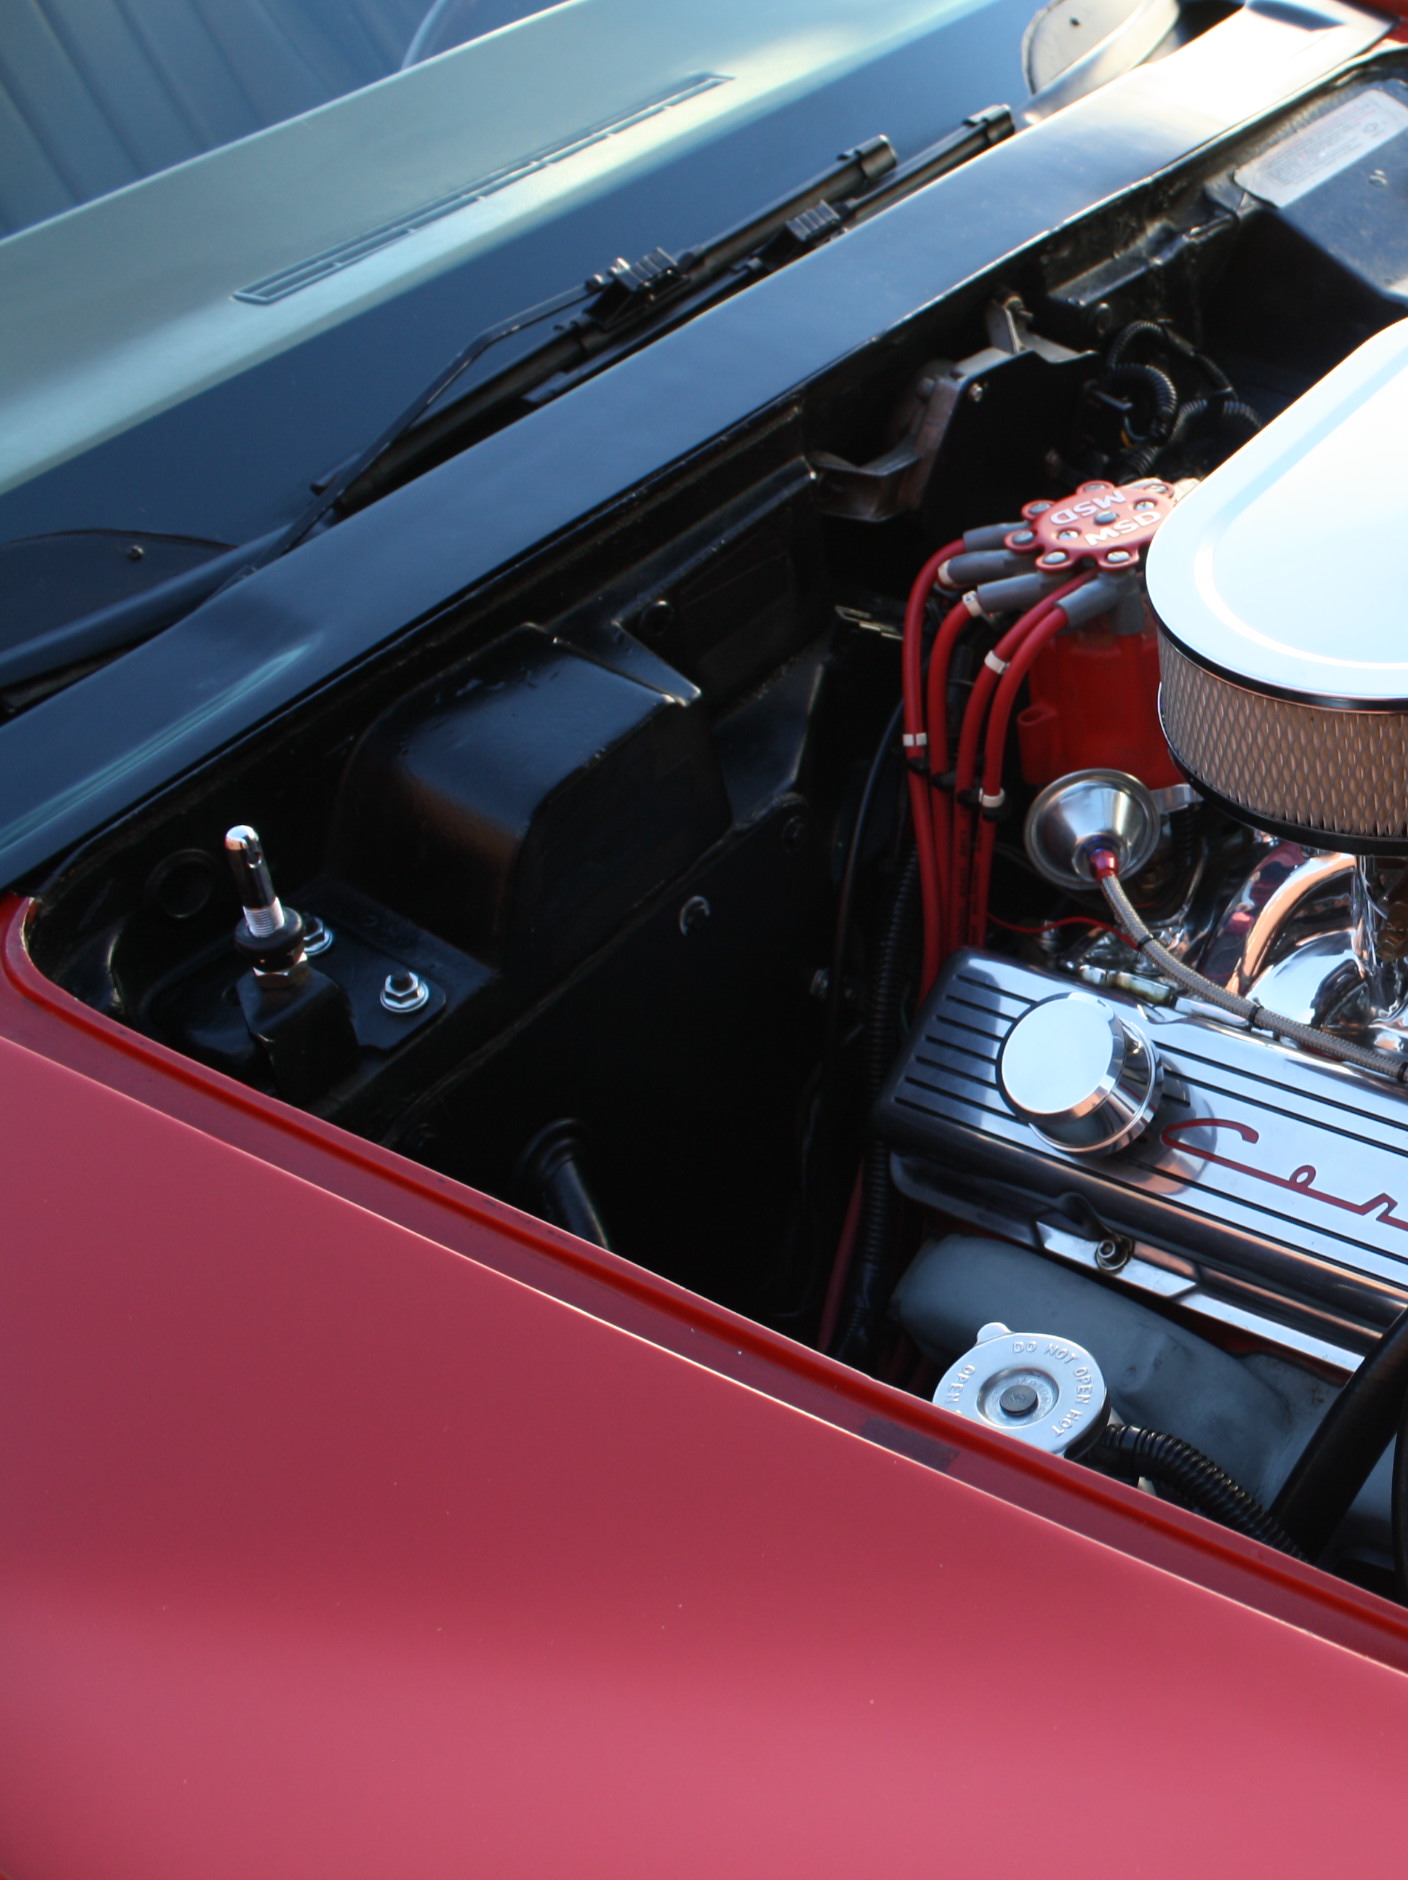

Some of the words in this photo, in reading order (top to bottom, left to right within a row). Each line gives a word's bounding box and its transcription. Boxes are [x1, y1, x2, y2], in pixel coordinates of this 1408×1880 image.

[1050, 490, 1127, 525] MSD
[1084, 511, 1161, 546] MSD
[1012, 1341, 1037, 1353] DO
[1044, 1343, 1078, 1364] NOT
[1073, 1366, 1092, 1404] OPEN
[1051, 1409, 1082, 1437] HOT
